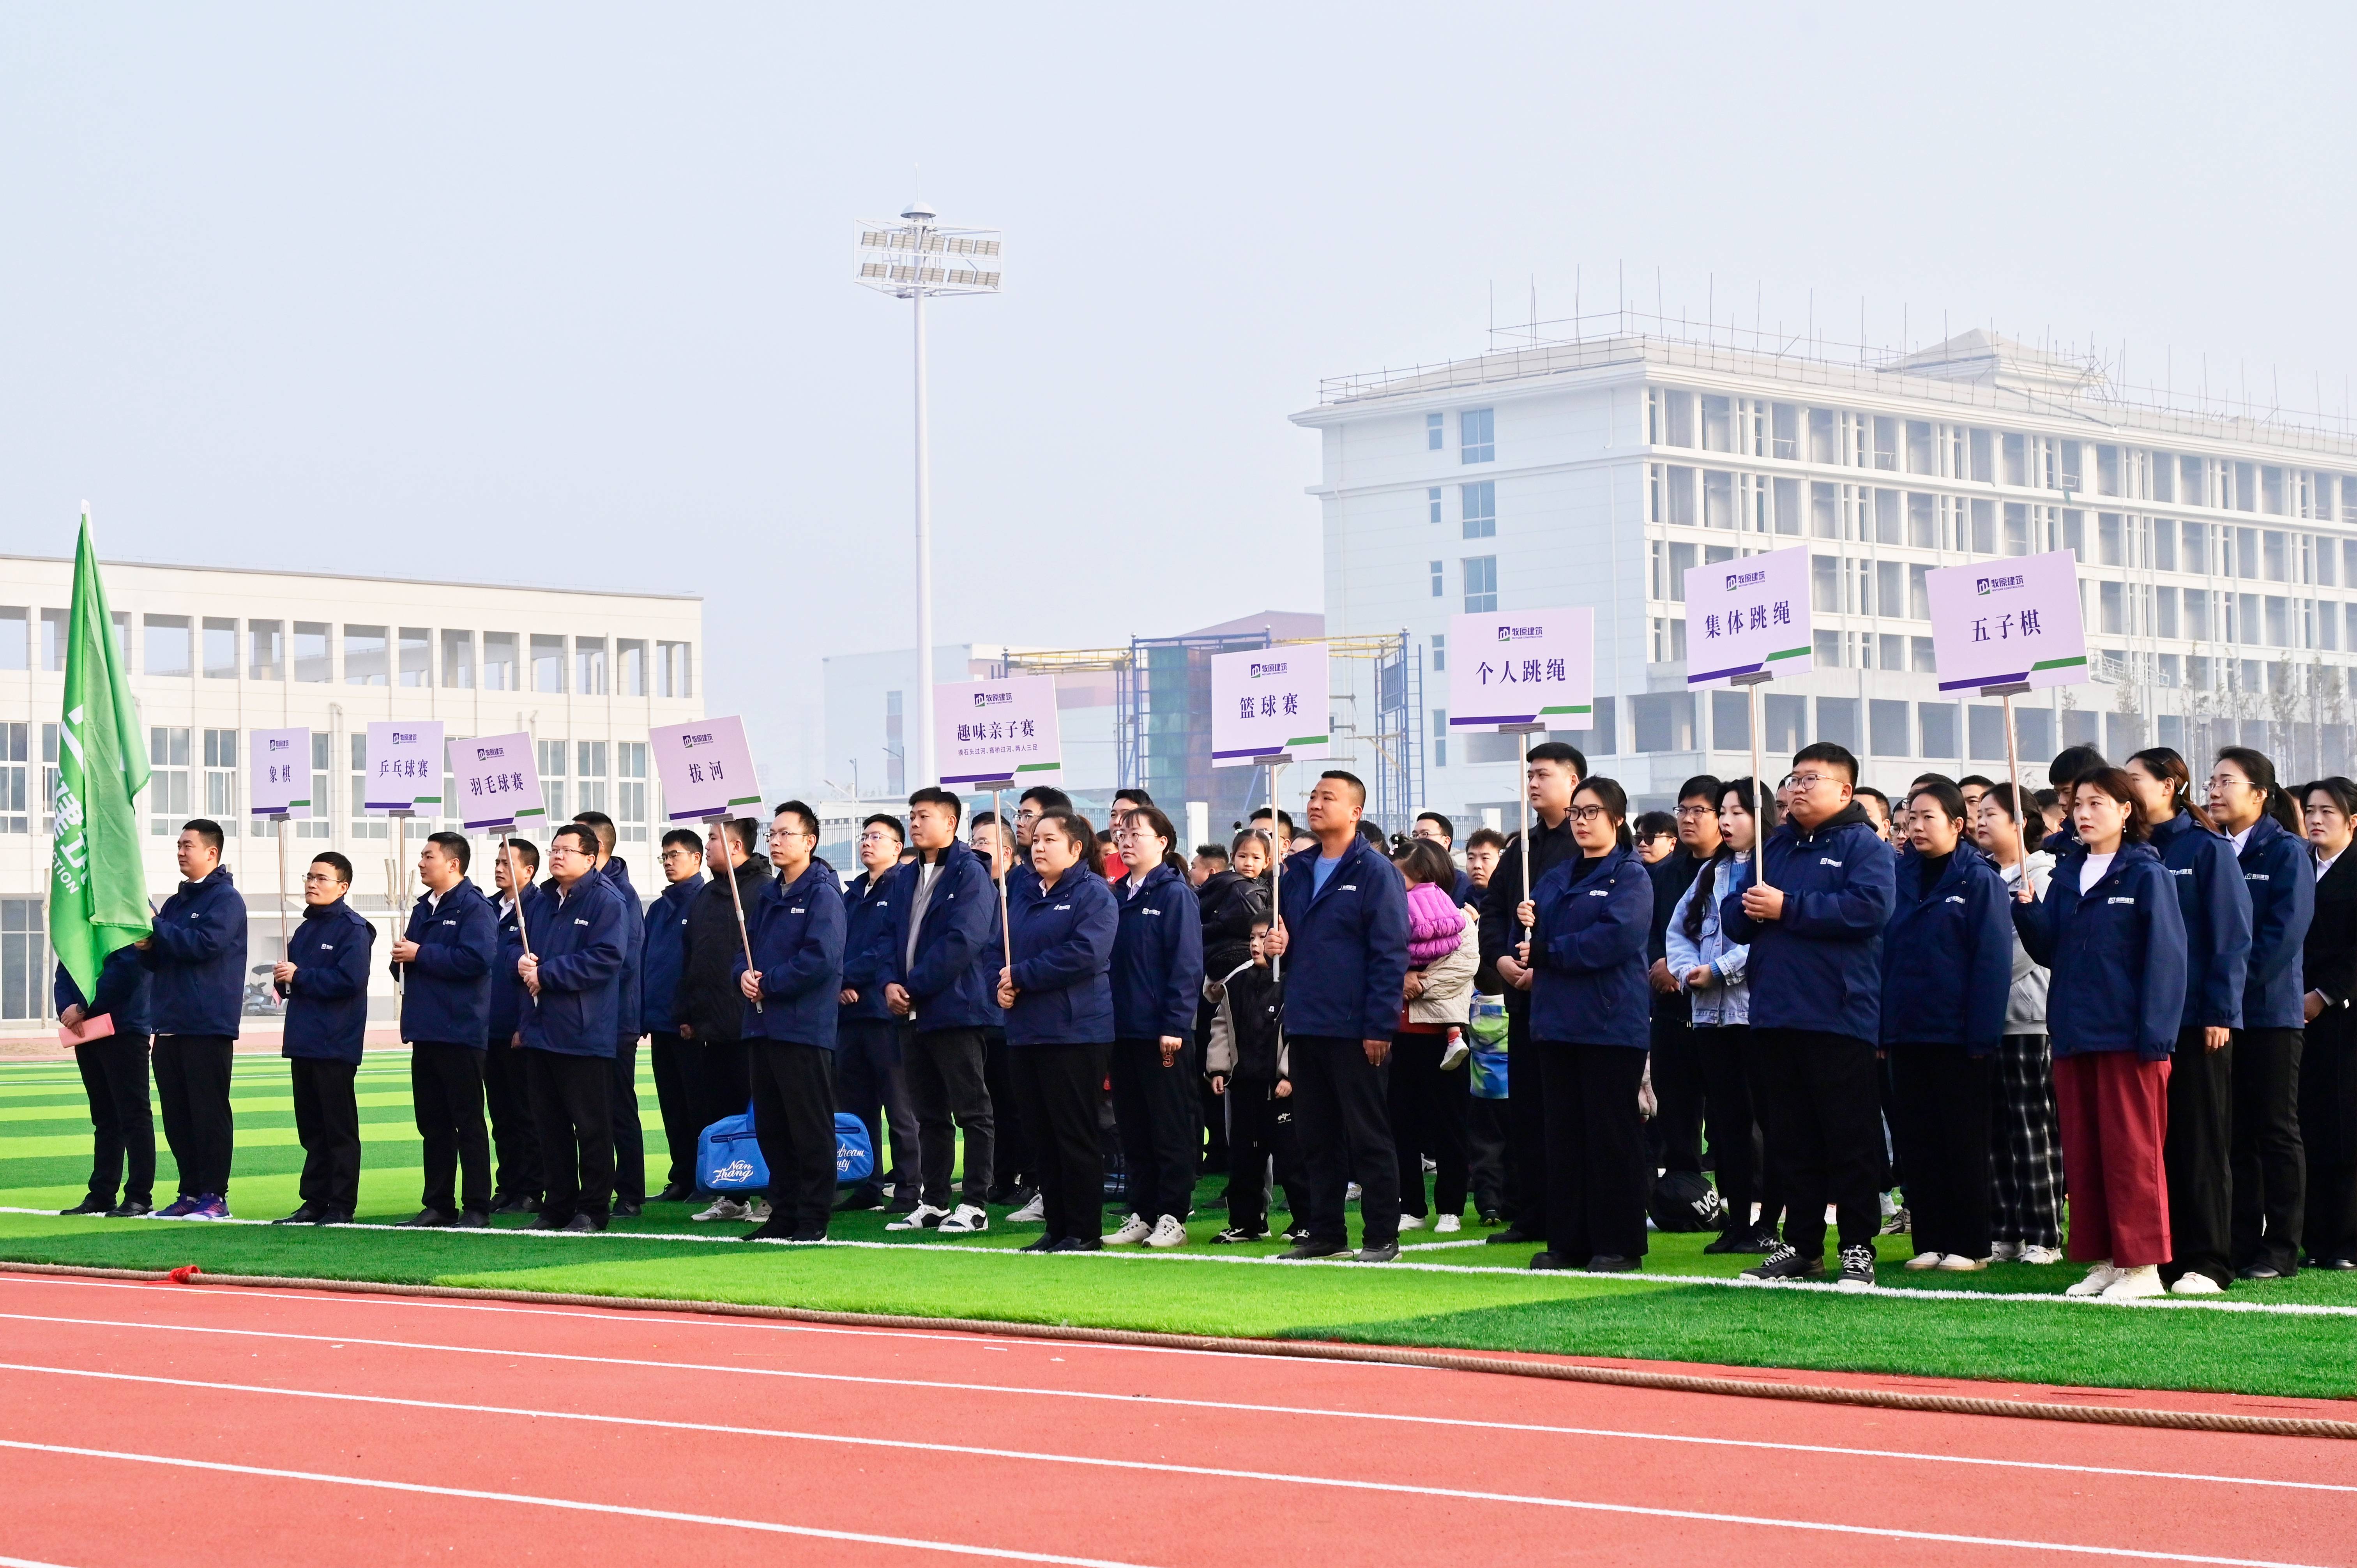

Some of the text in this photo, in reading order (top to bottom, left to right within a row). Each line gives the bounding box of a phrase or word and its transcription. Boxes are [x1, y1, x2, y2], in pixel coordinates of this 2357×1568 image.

[1738, 571, 1765, 584] 牧原建筑
[1991, 575, 2023, 588] 牧原建筑
[1705, 600, 1790, 639] 集体跳绳
[1970, 609, 2041, 642] 五子棋
[1512, 627, 1542, 636] 牧原建筑
[1262, 663, 1287, 673] 牧原建筑
[1475, 658, 1565, 685] 个人跳绳
[986, 692, 1012, 702] 牧原建筑
[1240, 693, 1298, 719] 篮球赛
[957, 719, 1034, 742] 趣味亲子赛
[269, 764, 290, 783] 象棋
[379, 759, 428, 778] 乒乓球赛
[689, 761, 723, 783] 拔河
[470, 772, 523, 796] 羽毛球赛
[726, 1160, 753, 1171] Nan
